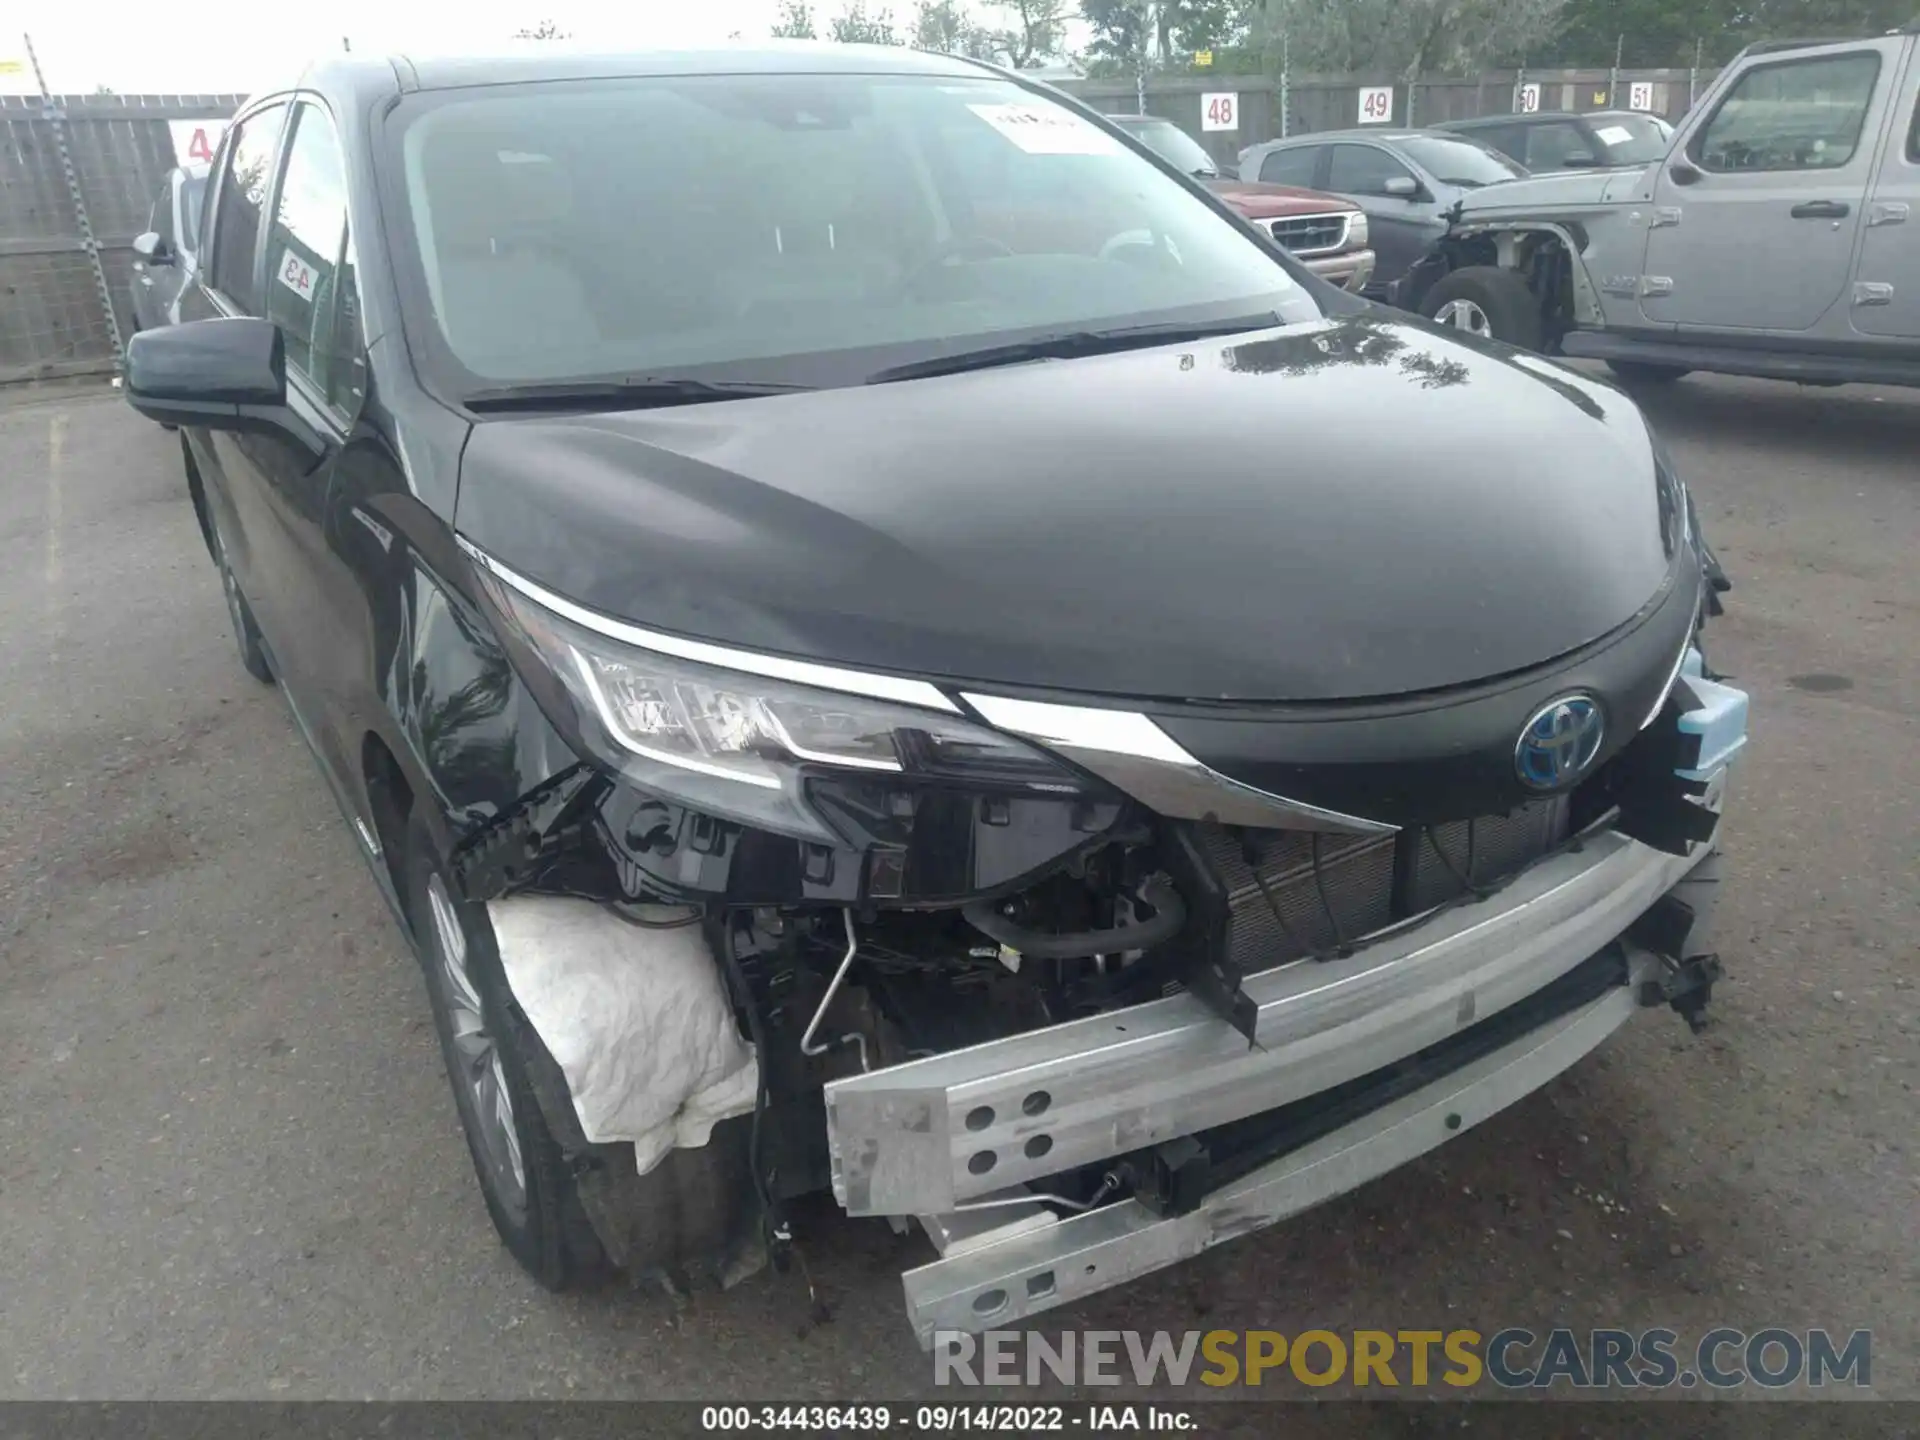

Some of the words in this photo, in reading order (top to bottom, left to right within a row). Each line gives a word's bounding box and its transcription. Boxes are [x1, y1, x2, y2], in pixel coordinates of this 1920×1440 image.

[1363, 92, 1387, 117] 49
[1632, 87, 1648, 109] 51
[1208, 98, 1232, 124] 48
